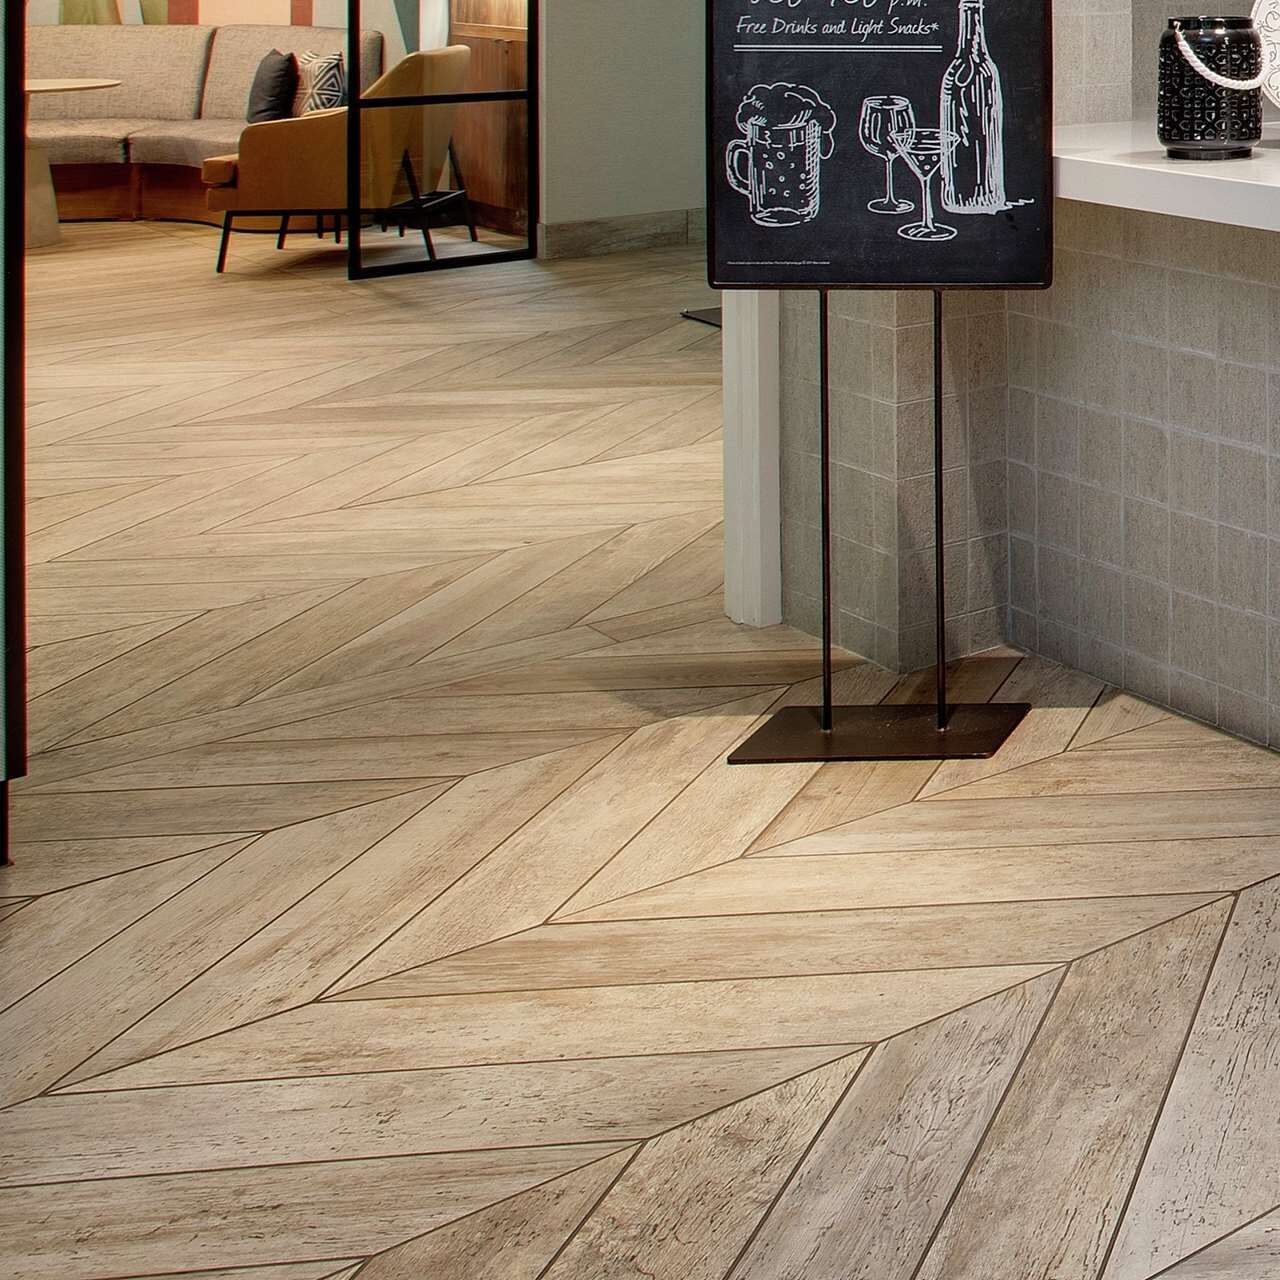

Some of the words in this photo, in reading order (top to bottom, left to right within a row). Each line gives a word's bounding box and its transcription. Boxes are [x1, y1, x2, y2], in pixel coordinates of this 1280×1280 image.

[736, 16, 767, 35] Free
[771, 18, 817, 35] Drinks
[822, 19, 847, 34] and
[851, 19, 884, 42] Light
